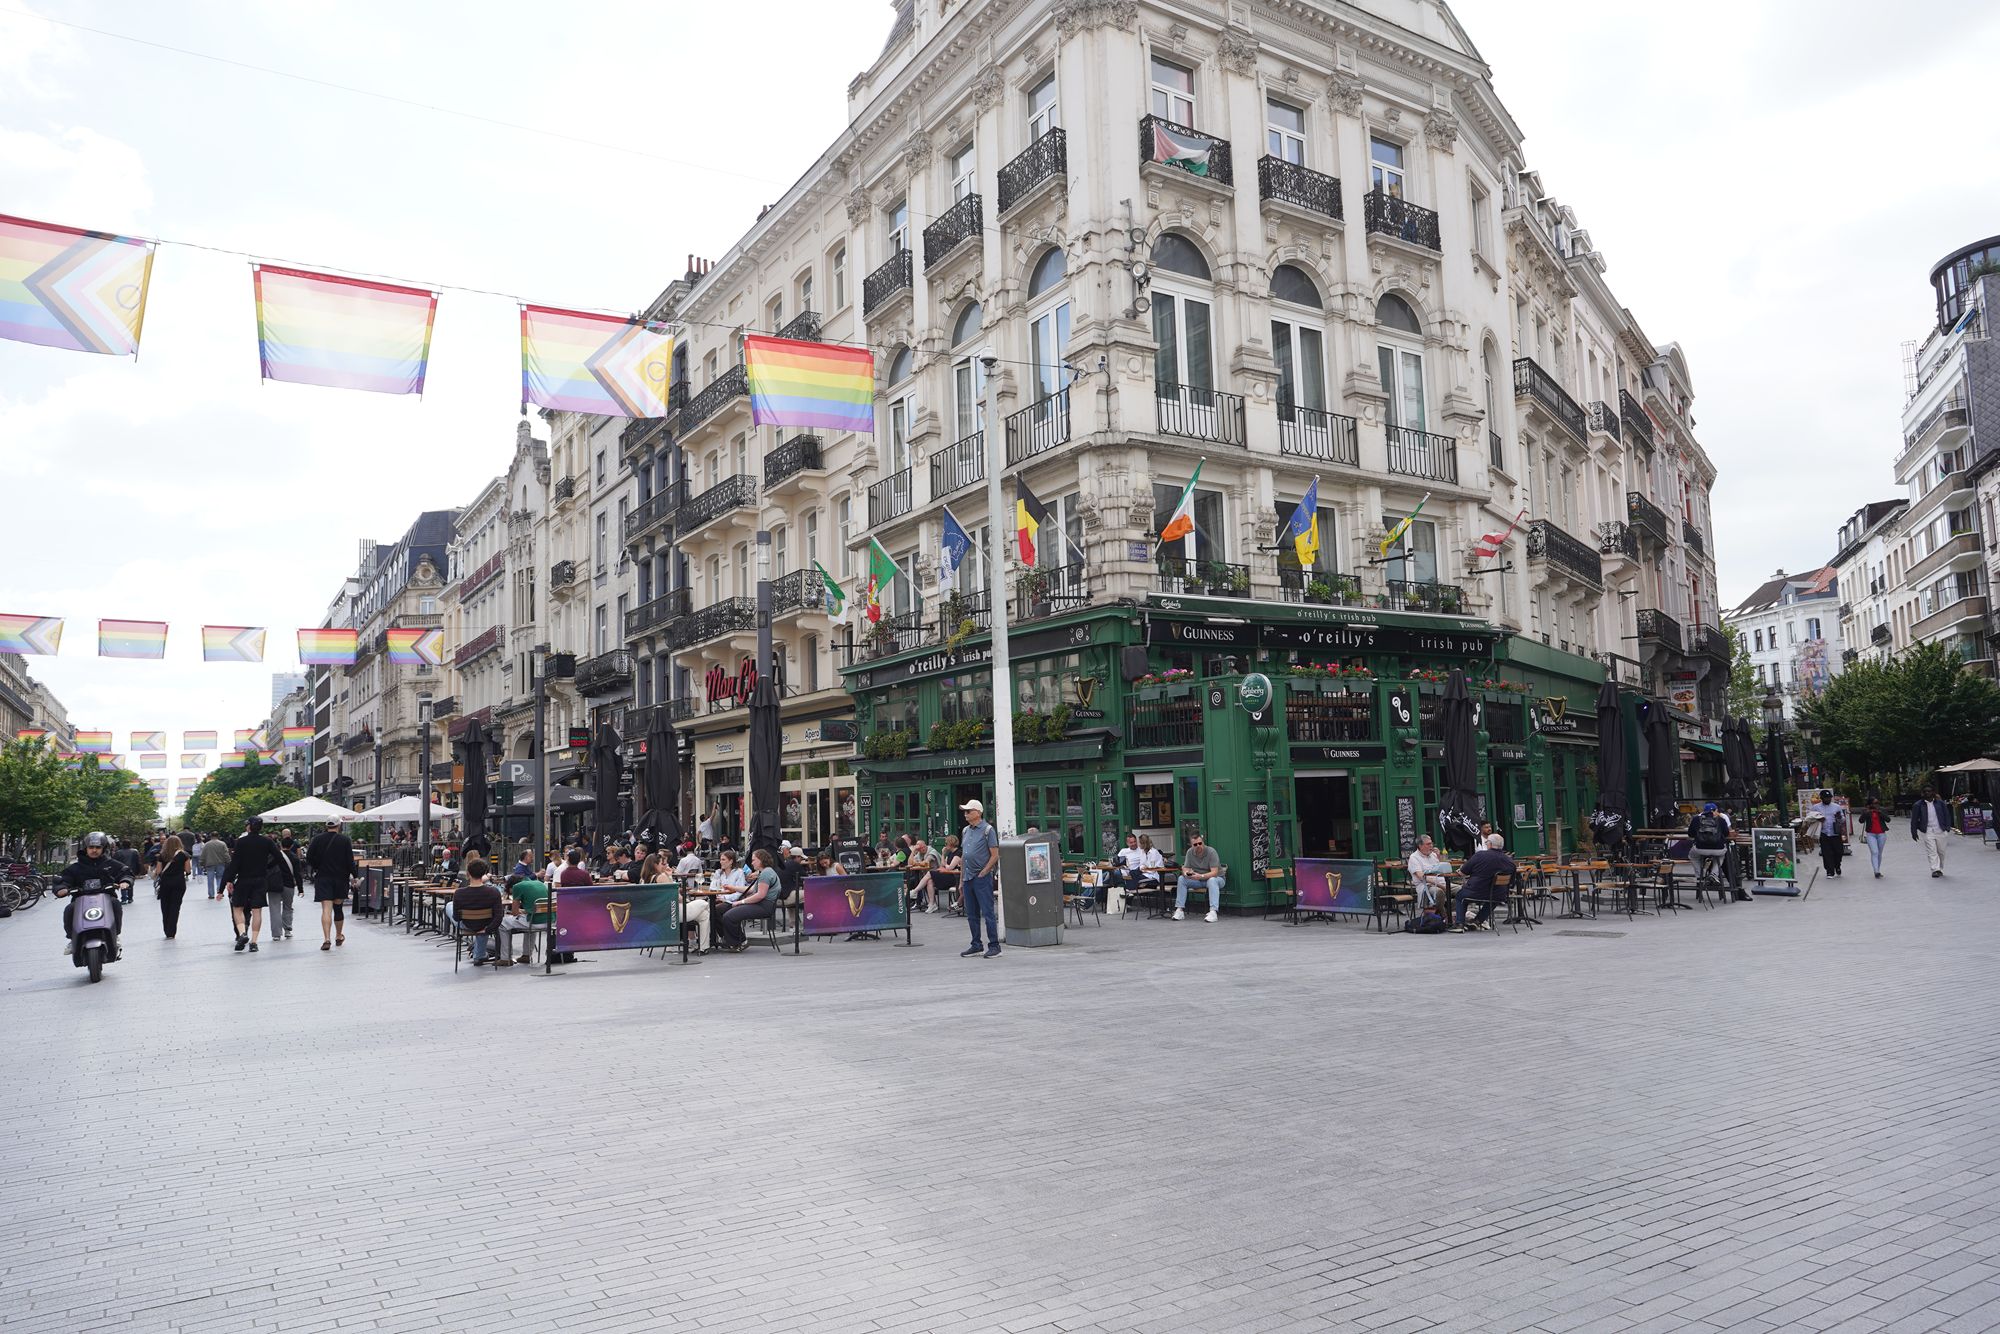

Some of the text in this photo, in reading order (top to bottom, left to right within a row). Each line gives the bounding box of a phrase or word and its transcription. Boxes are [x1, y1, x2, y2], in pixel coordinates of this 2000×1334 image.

[1297, 609, 1376, 622] o'reilly's irish pub
[1183, 626, 1234, 641] GUINNESS
[1303, 629, 1483, 653] o'reilly's irish pub
[909, 653, 956, 674] o'reilly's
[963, 649, 981, 662] irish
[705, 659, 758, 704] Mon Ch
[1330, 749, 1359, 758] GUINNESS
[1502, 750, 1514, 758] irish
[943, 757, 969, 766] irish pub
[511, 764, 525, 782] P
[947, 766, 986, 775] irish pub
[1963, 807, 1981, 815] NEW
